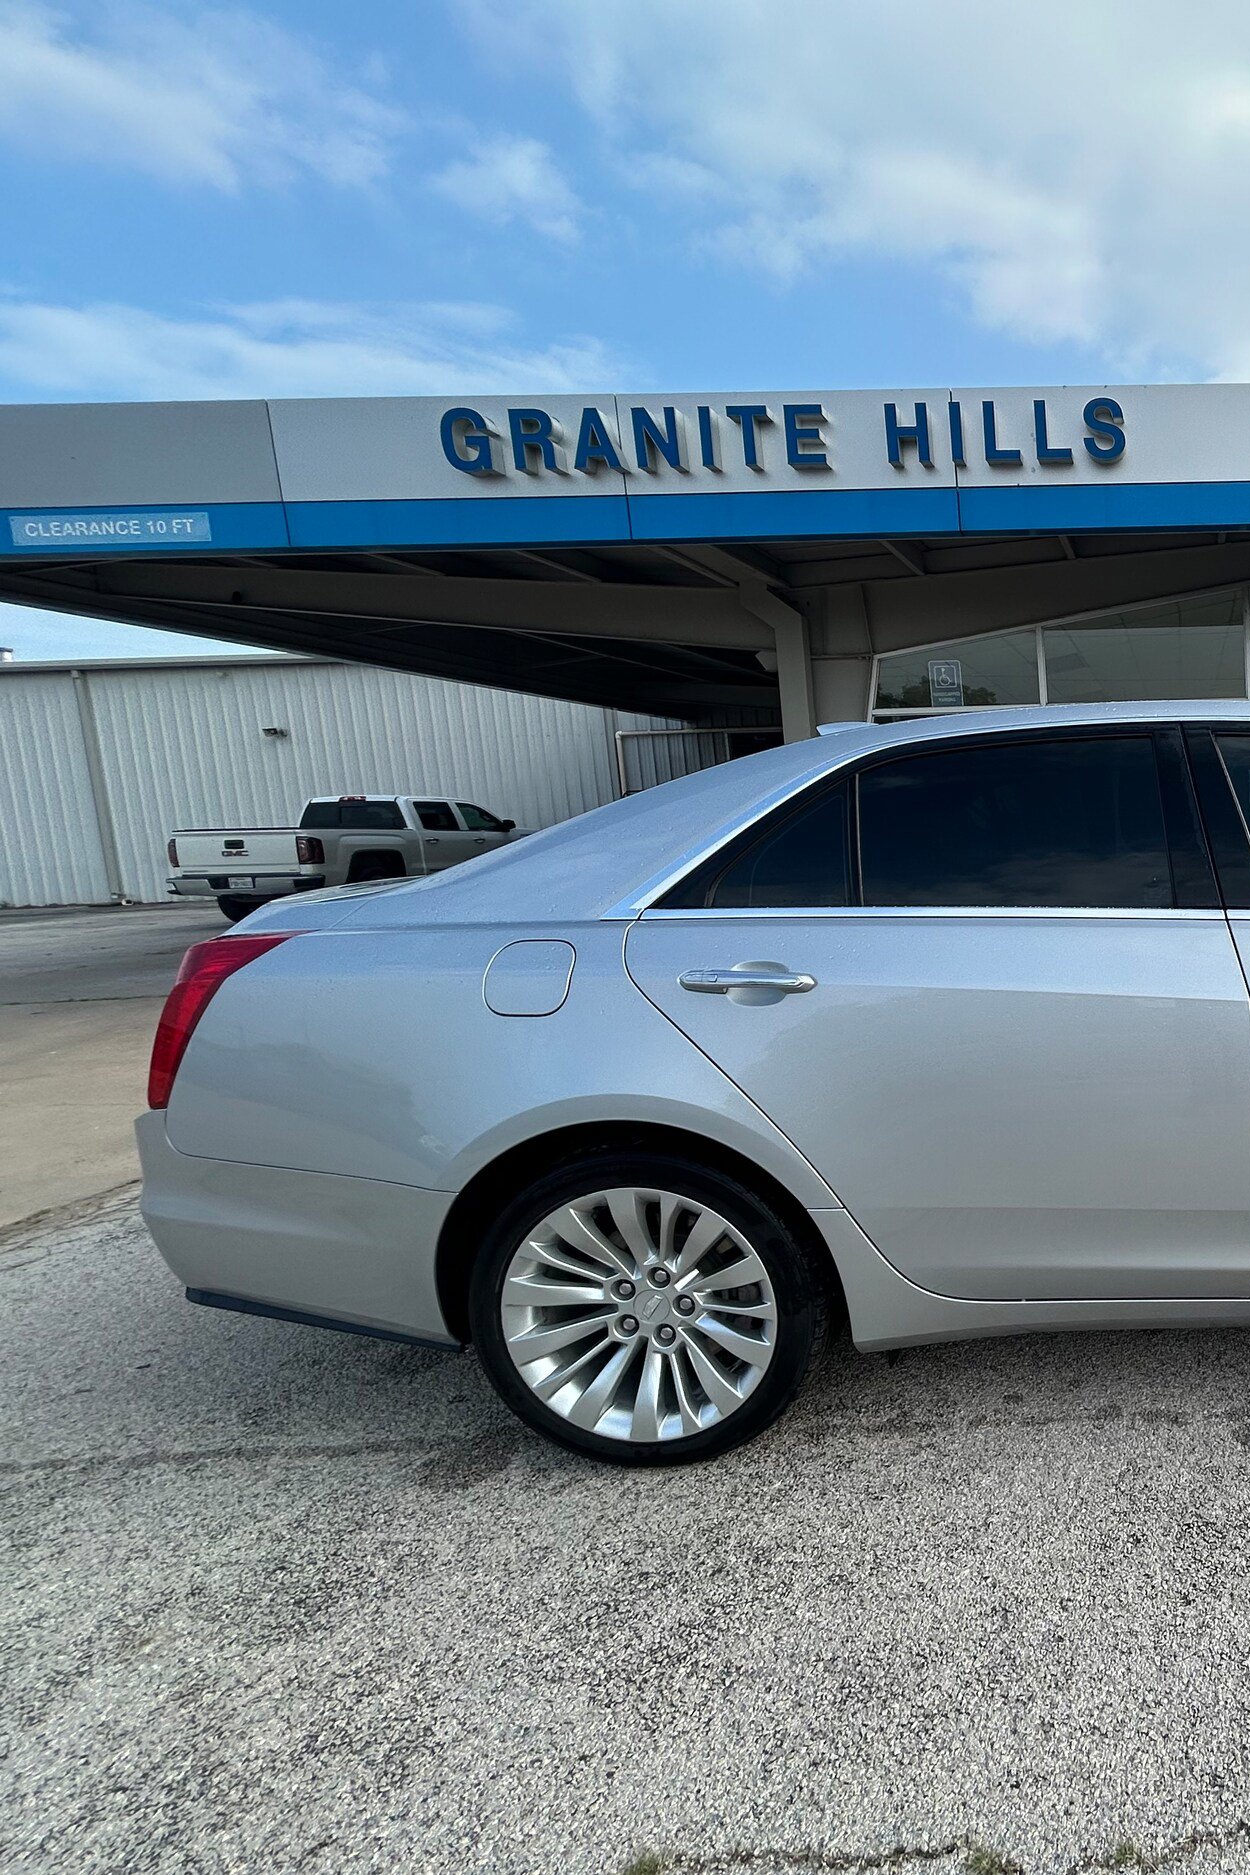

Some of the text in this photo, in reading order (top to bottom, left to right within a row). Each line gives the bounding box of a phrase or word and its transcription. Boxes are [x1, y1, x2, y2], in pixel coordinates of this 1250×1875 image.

[440, 397, 1127, 477] GRANITE HILLS
[25, 518, 194, 537] CLEARANCE 10 FT
